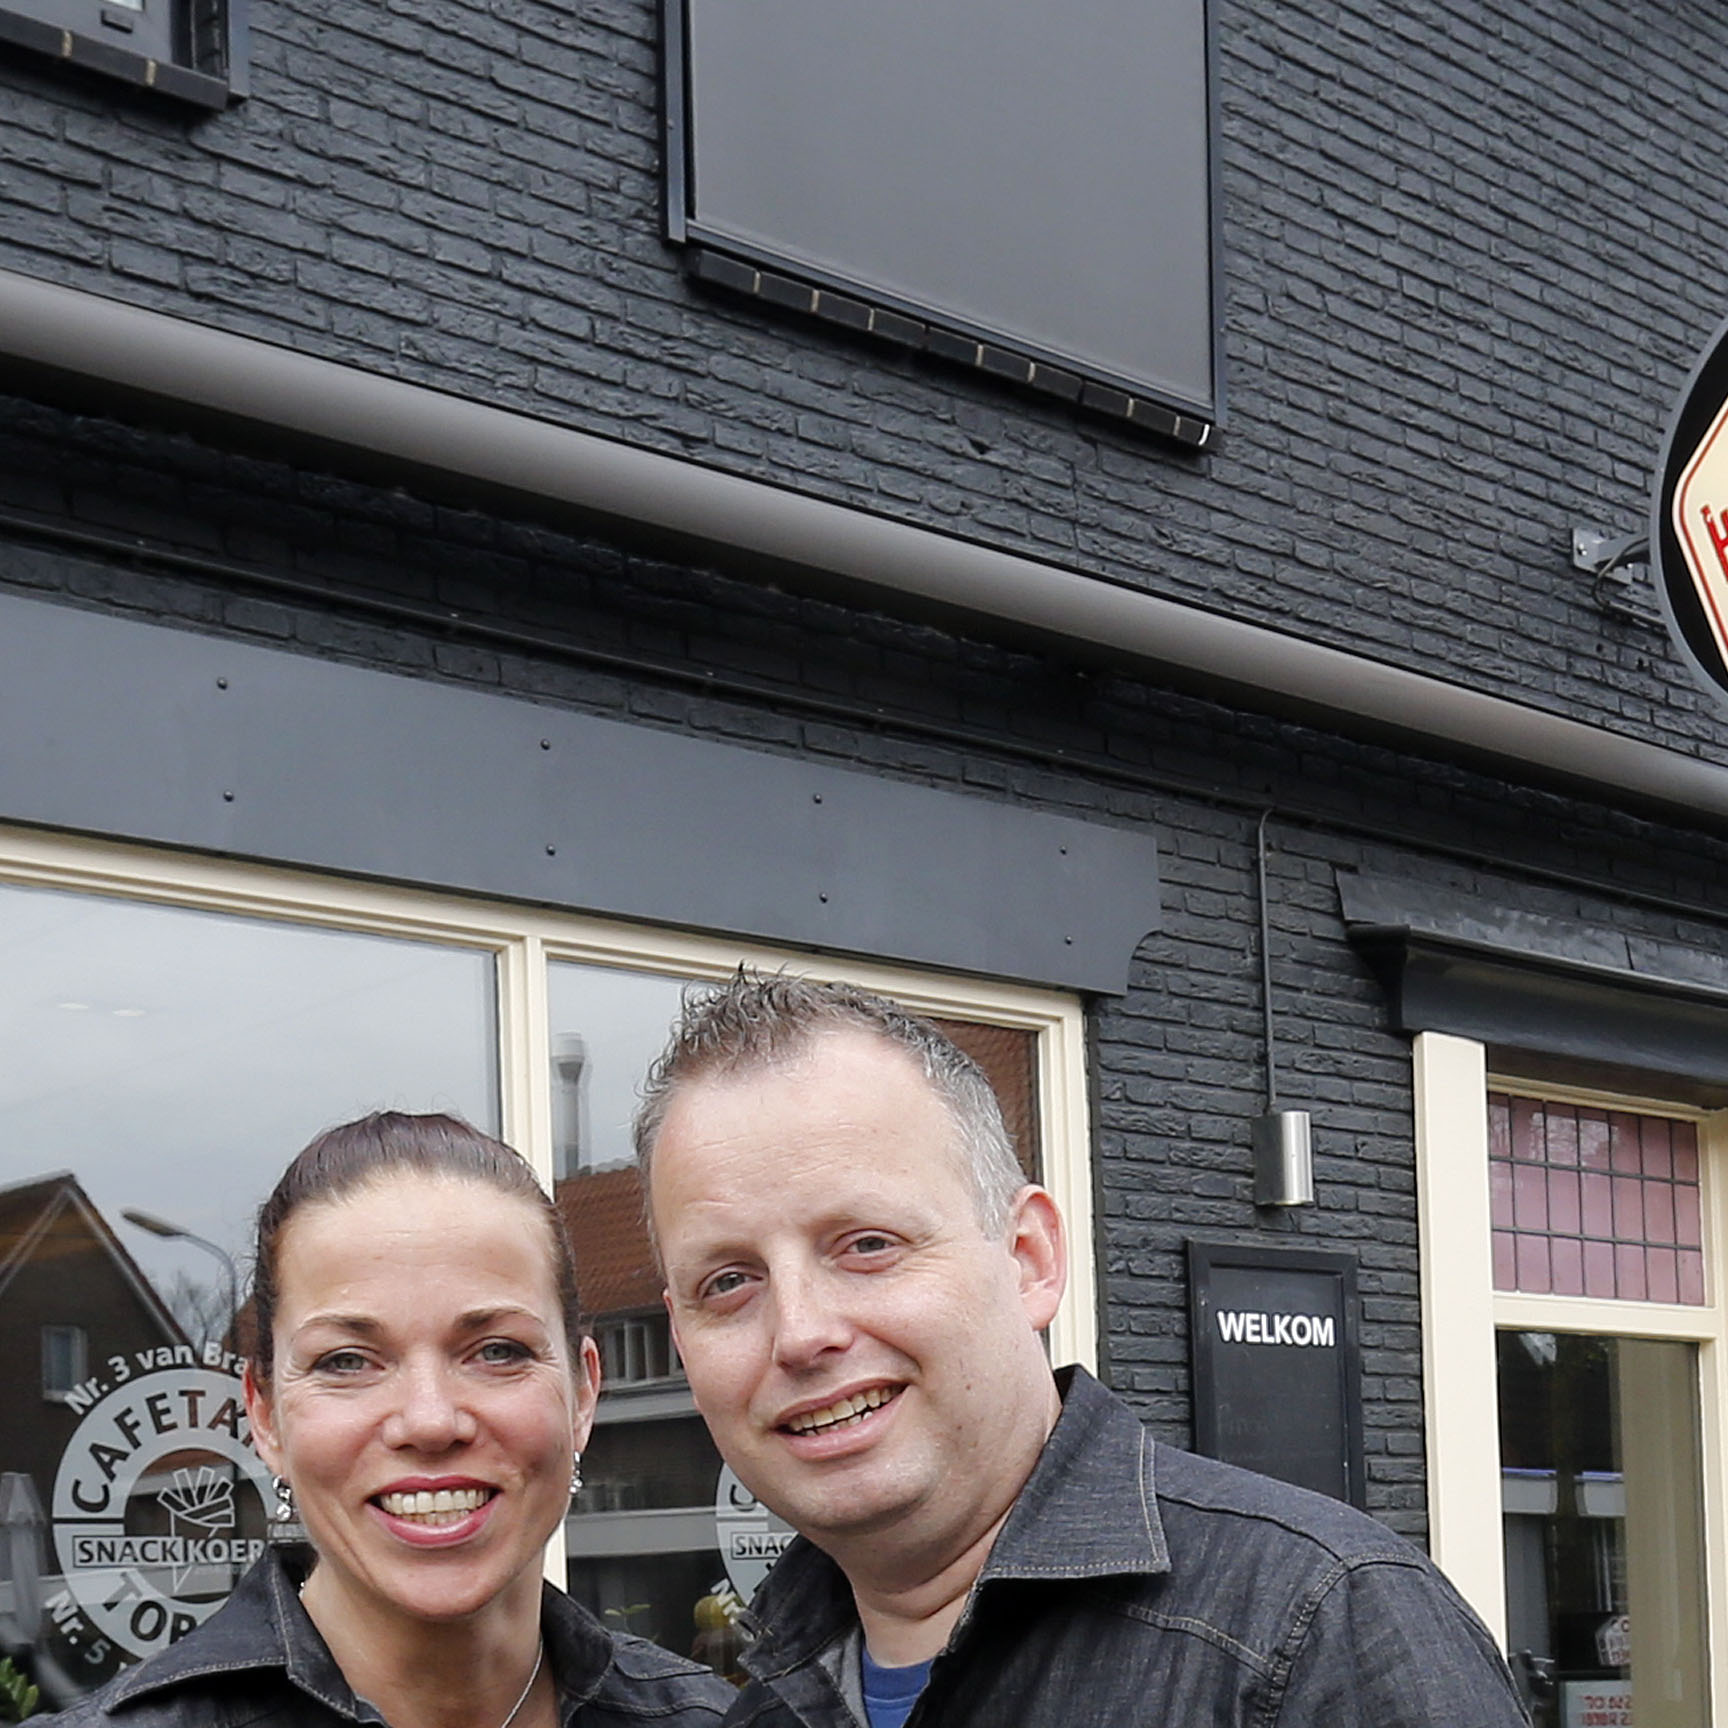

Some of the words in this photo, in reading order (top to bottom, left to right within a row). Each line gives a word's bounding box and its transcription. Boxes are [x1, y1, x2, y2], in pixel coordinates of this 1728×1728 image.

[1217, 1310, 1336, 1347] WELKOM
[64, 1376, 109, 1415] Nr.
[107, 1355, 131, 1383] 3
[135, 1344, 194, 1372] van
[203, 1340, 249, 1376] Bra
[71, 1390, 256, 1514] CAFETA
[186, 1538, 267, 1564] KOER
[45, 1589, 84, 1645] Nr.
